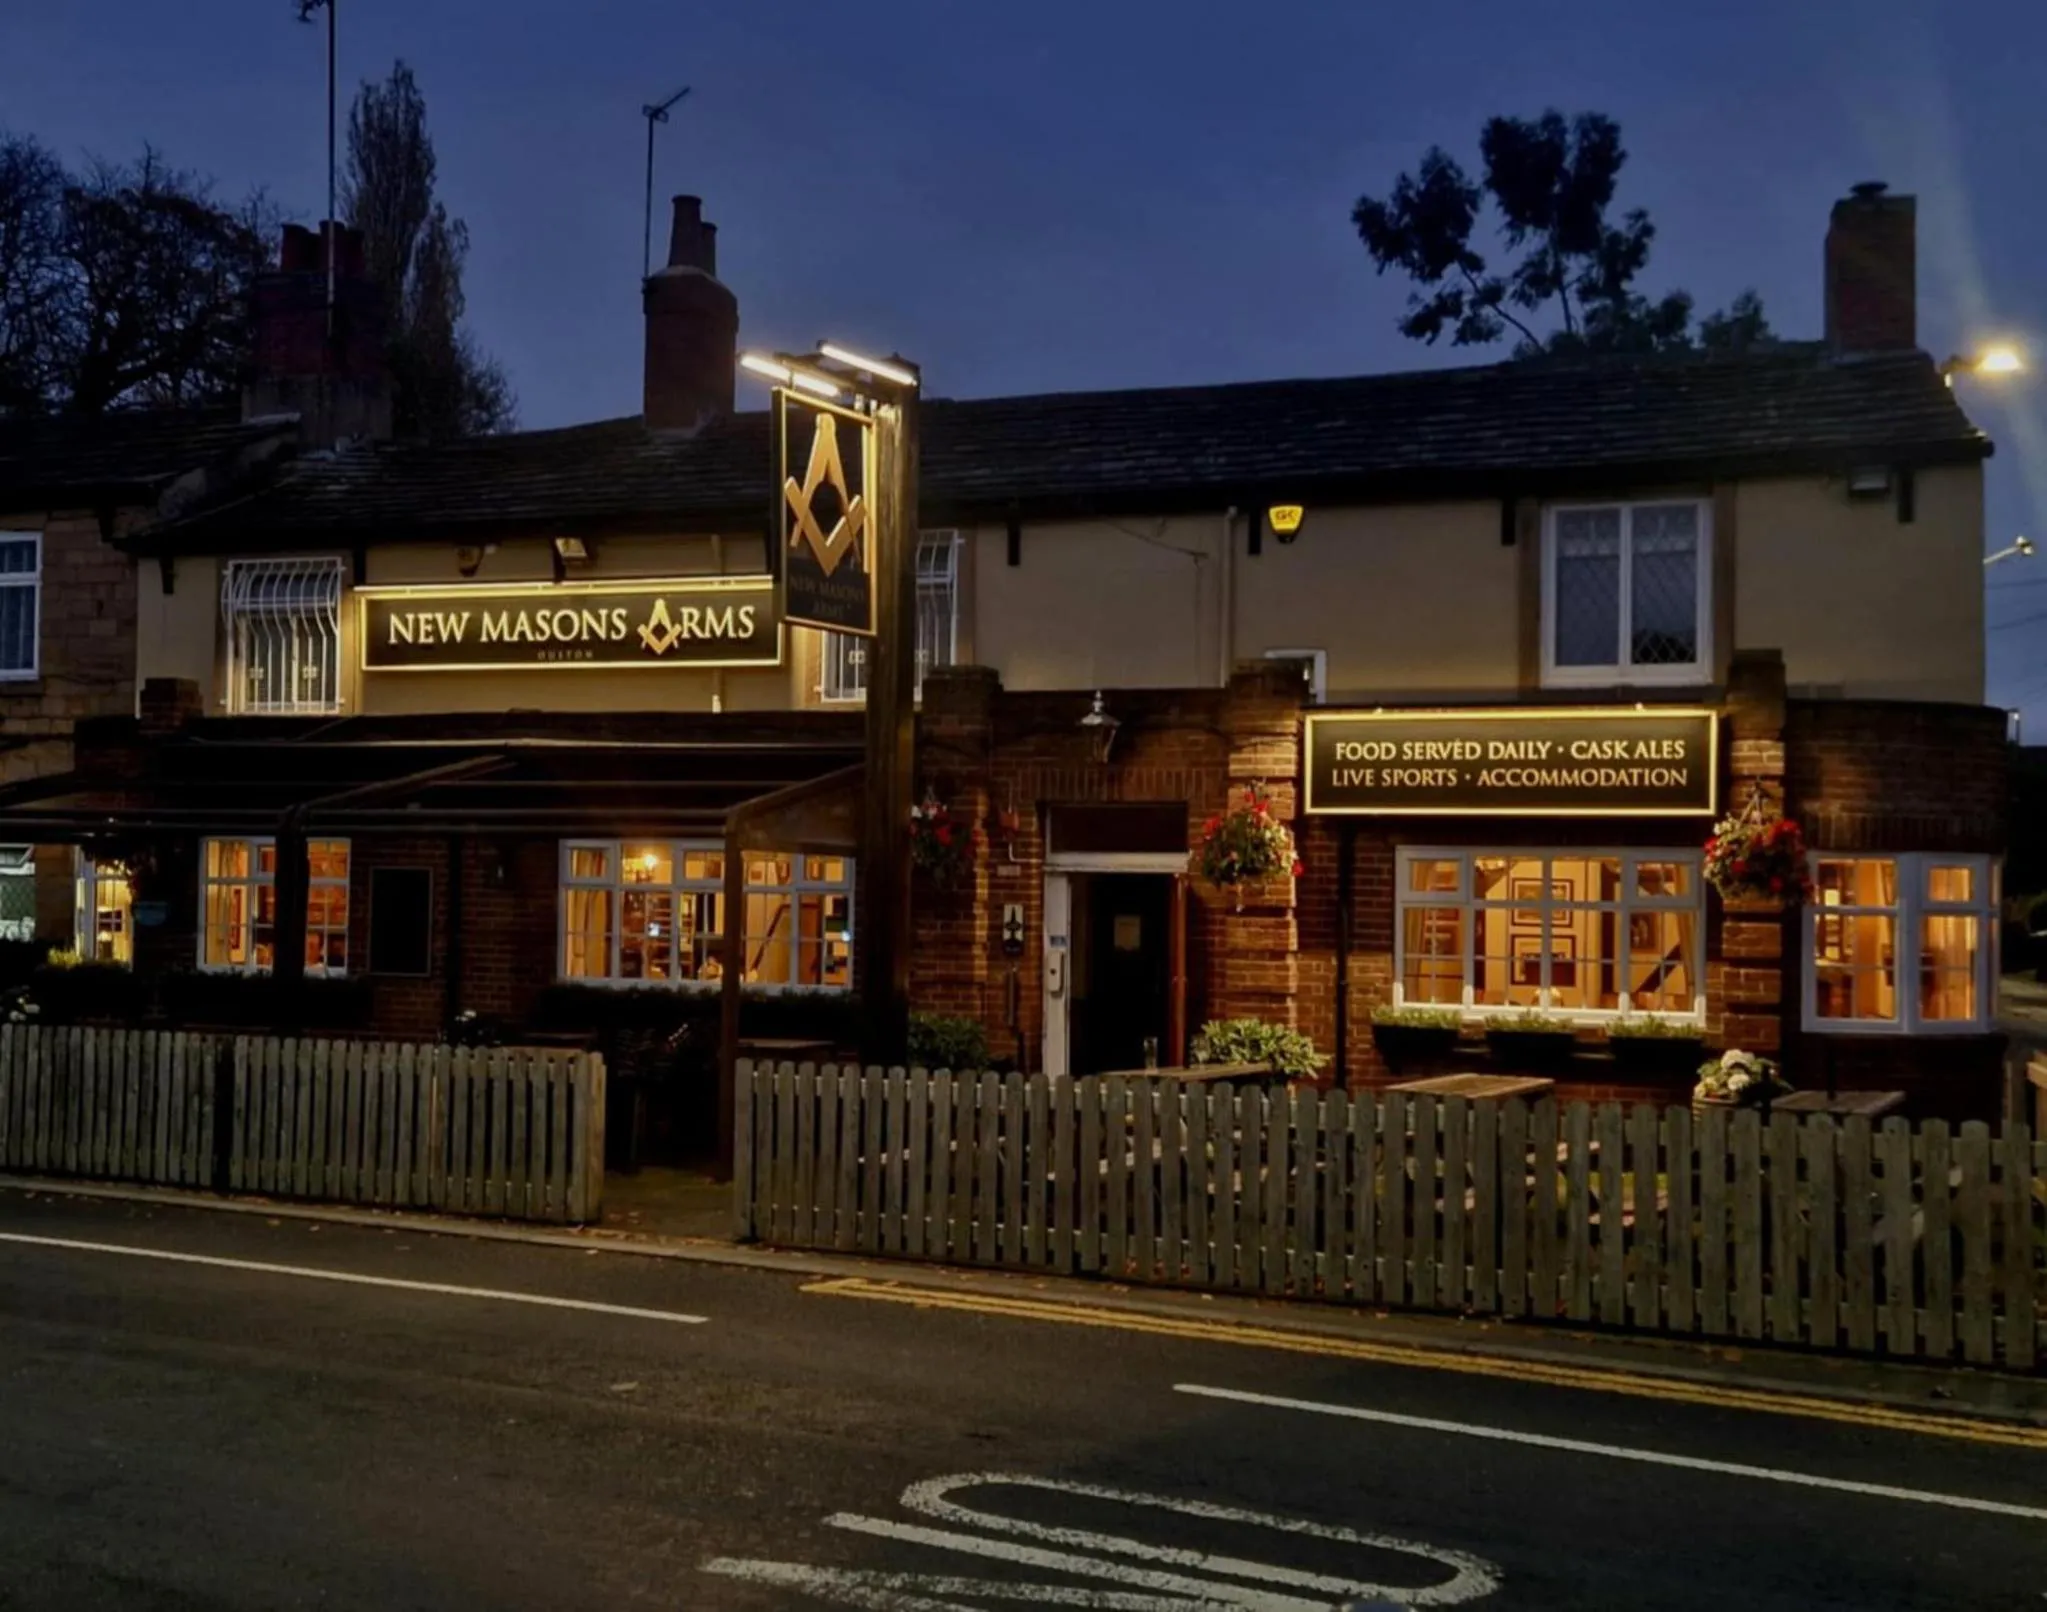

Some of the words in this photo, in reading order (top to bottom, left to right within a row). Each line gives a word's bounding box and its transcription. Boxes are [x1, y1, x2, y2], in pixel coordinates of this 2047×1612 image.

[390, 611, 471, 643] NEW
[480, 608, 627, 642] MASONS
[1336, 742, 1396, 760] FOOD
[1403, 740, 1481, 760] SERVED
[1488, 741, 1552, 759] DAILY
[1571, 740, 1629, 759] CASK
[1634, 740, 1684, 759] ALES
[1333, 769, 1373, 785] LIVE
[1382, 769, 1457, 785] SPORTS
[1478, 768, 1686, 786] ACCOMMODATION
